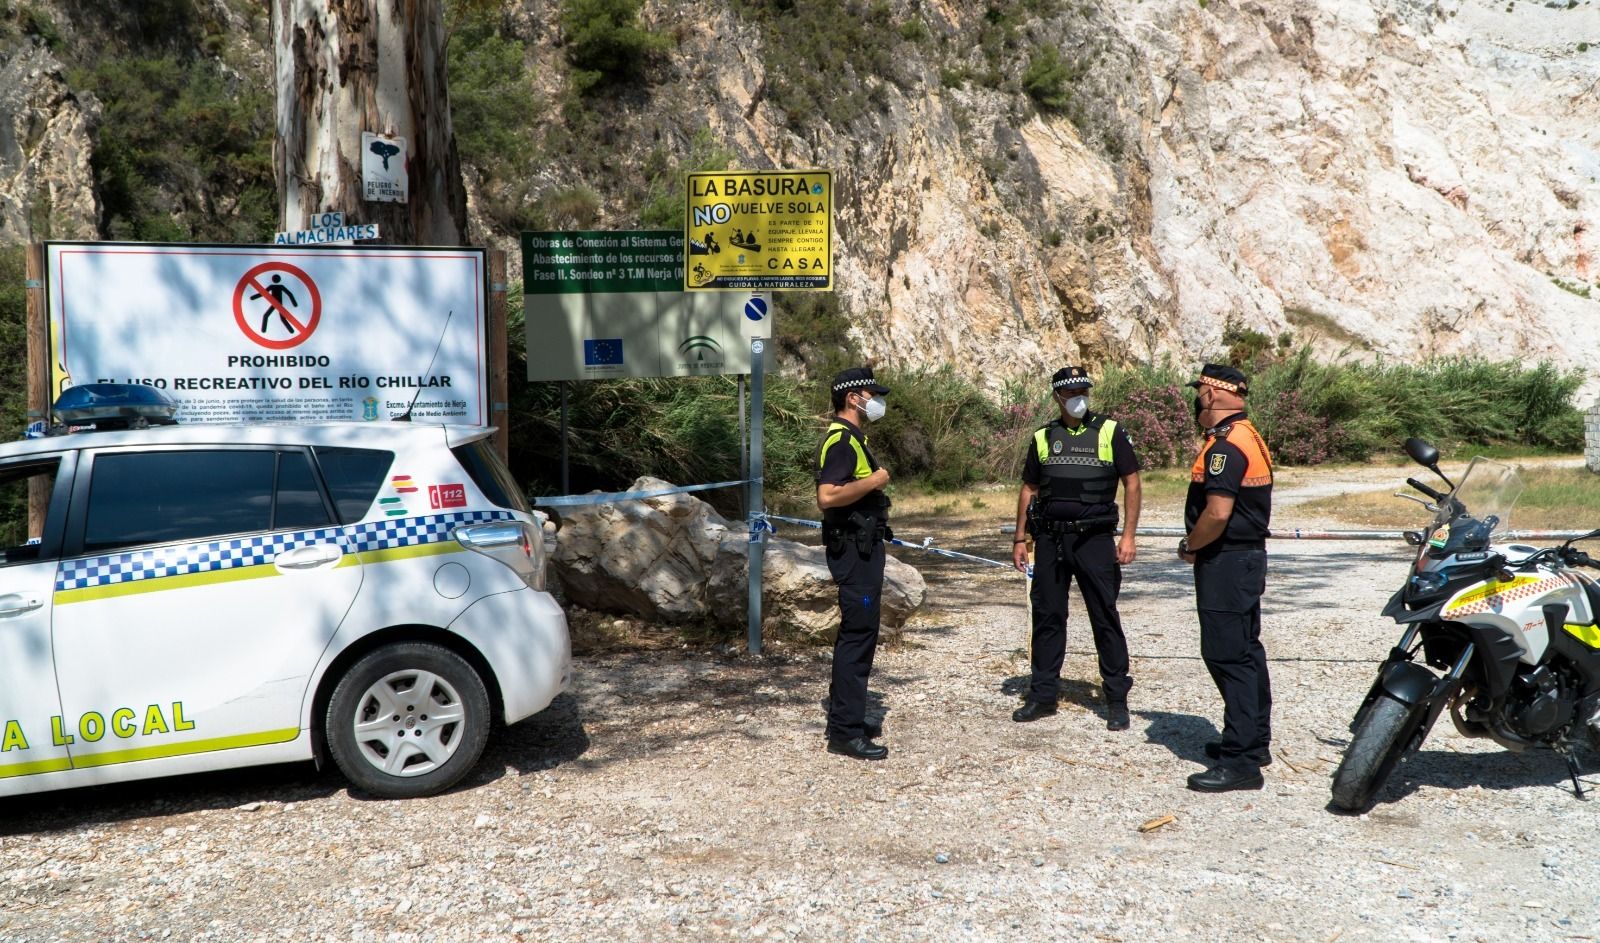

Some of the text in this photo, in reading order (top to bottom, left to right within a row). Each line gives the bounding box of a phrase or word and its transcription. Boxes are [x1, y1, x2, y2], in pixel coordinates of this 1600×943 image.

[367, 181, 392, 189] PELIGRO
[693, 178, 810, 197] LA BASURA
[731, 202, 825, 214] VUELVE SOLA
[312, 213, 342, 229] LOS
[693, 203, 732, 227] NO
[276, 225, 375, 245] ALMACHARES
[532, 237, 560, 248] Obras
[562, 237, 574, 248] de
[576, 236, 619, 248] Conexión
[620, 237, 629, 248] al
[631, 236, 668, 248] Sistema
[533, 253, 604, 265] Abastecimiento
[606, 253, 617, 264] de
[619, 252, 633, 263] los
[635, 254, 674, 263] recursos
[767, 258, 824, 270] CASA
[534, 270, 556, 281] Fase
[569, 269, 604, 280] Sondeo
[619, 268, 625, 279] 3
[628, 268, 645, 280] T.M
[647, 268, 672, 281] Nerja
[228, 355, 330, 368] PROHIBIDO
[174, 377, 293, 390] RECREATIVO
[299, 377, 333, 389] DEL
[339, 374, 370, 389] RÍO
[376, 376, 452, 388] CHILLAR
[386, 401, 406, 409] Excmo.
[452, 400, 467, 409] Nerja
[443, 489, 463, 499] 112
[1, 701, 195, 752] A LOCAL
